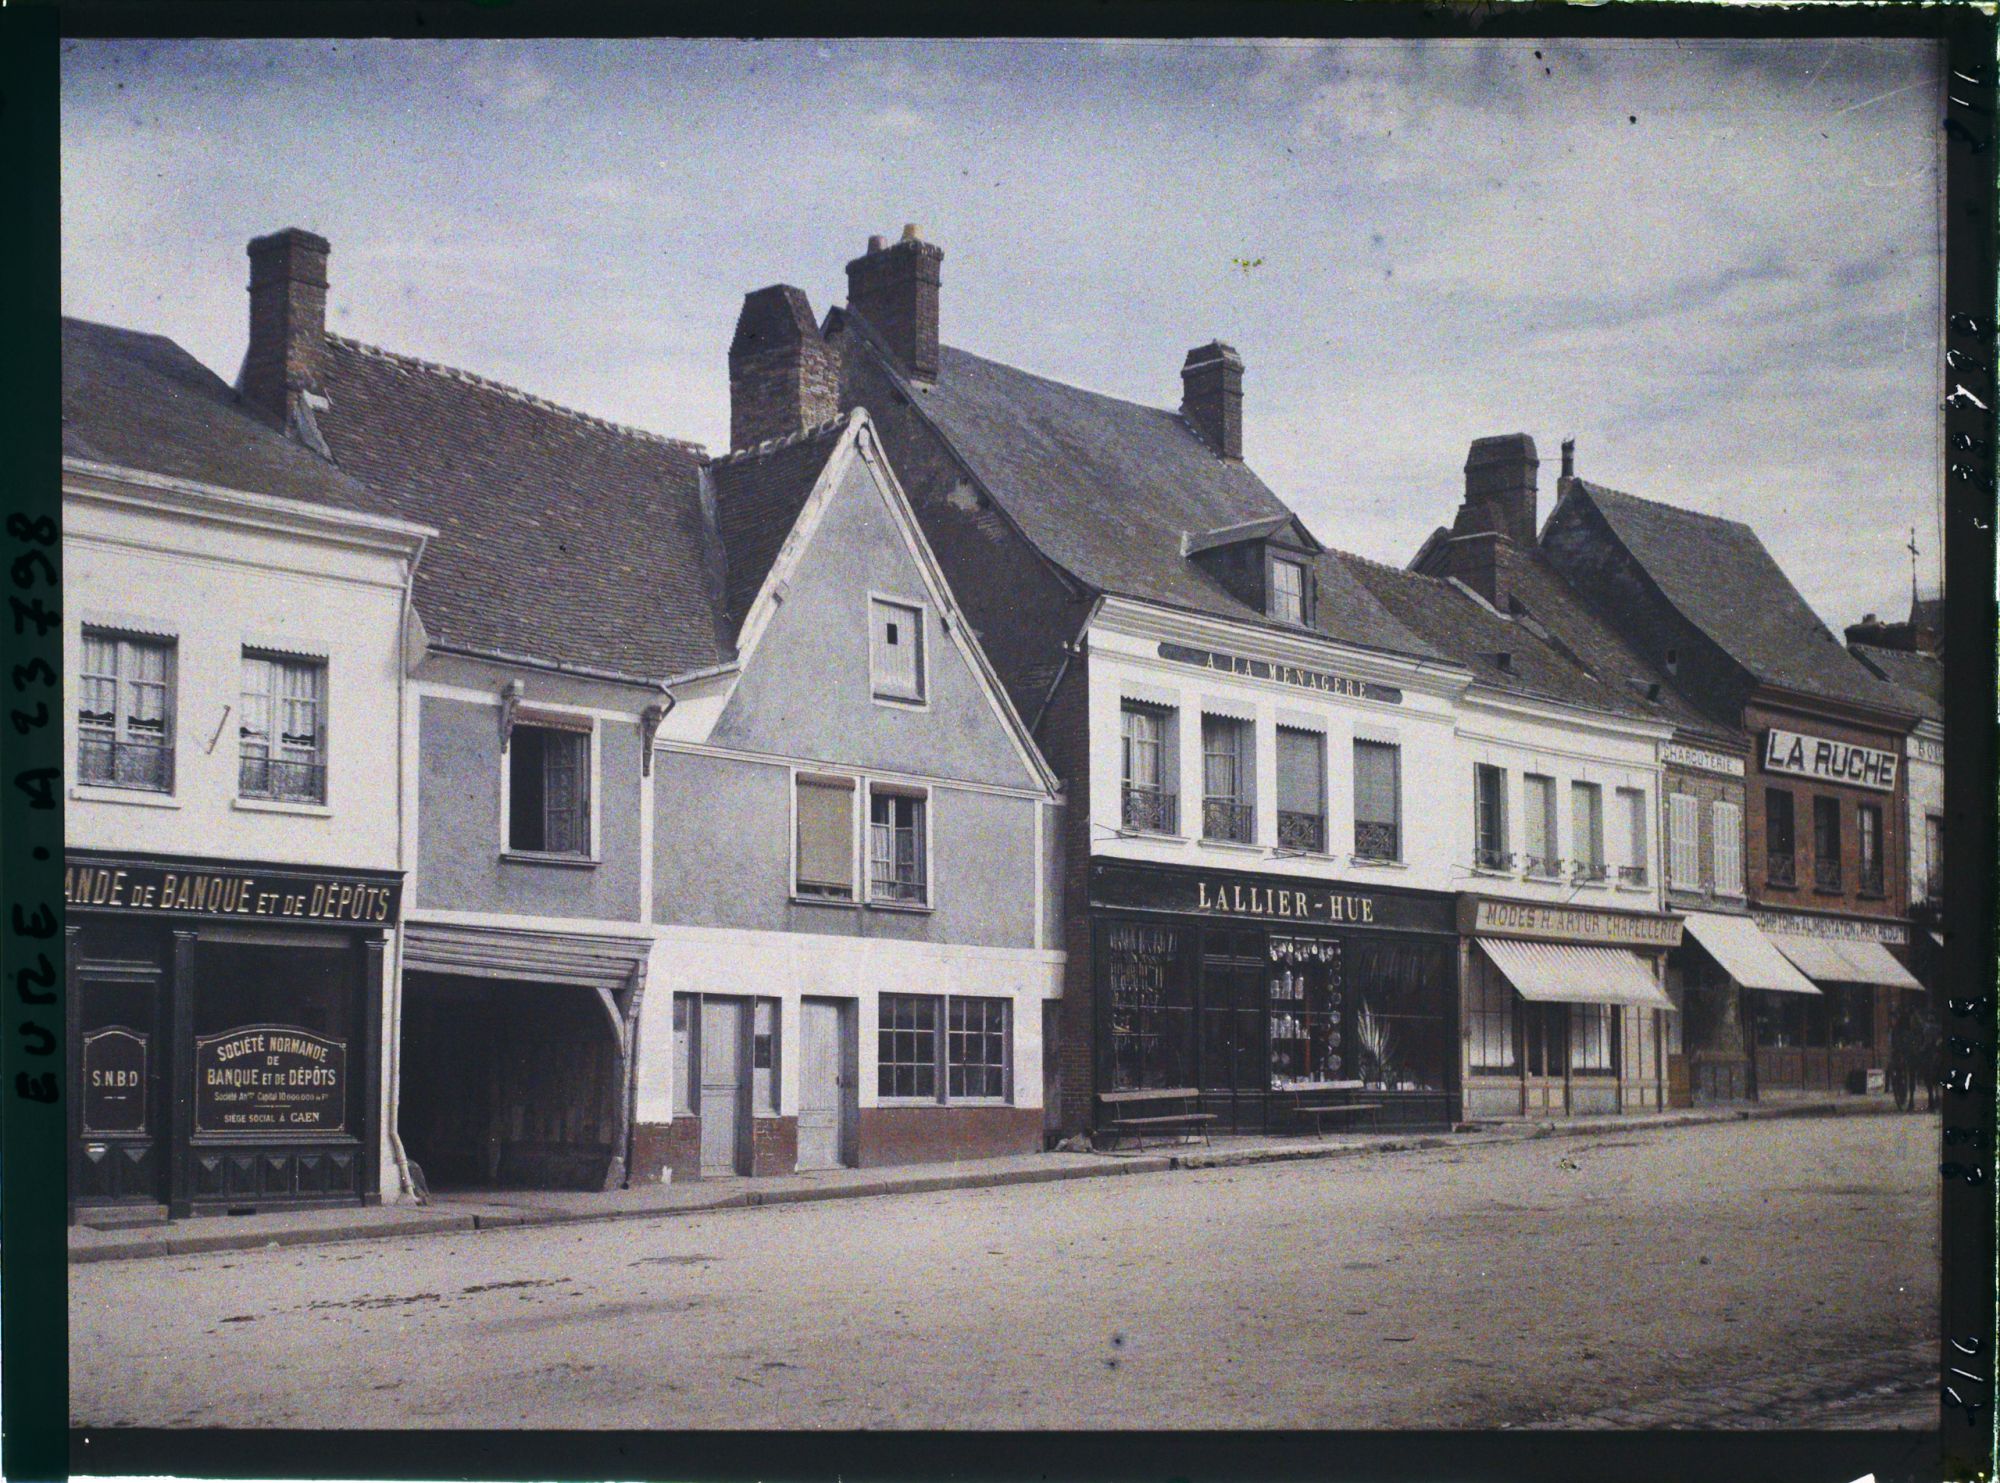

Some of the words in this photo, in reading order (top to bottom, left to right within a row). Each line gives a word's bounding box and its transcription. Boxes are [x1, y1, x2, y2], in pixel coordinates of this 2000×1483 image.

[8, 511, 61, 737] 23798
[1231, 656, 1253, 677] LA
[1767, 732, 1805, 771] LA
[1814, 741, 1896, 785] RUCHE
[14, 768, 62, 810] A
[130, 886, 156, 907] DE
[160, 874, 254, 914] BANQUE
[256, 893, 280, 914] ET
[283, 895, 306, 916] DE
[309, 882, 390, 921] DÉPÔTS
[1487, 903, 1536, 928] MODES
[1606, 916, 1678, 940] CHAPELLERIE
[12, 902, 60, 1104] EURE
[217, 1034, 264, 1061] SOCIÉTÉ
[269, 1037, 328, 1062] NORMANDE
[267, 1056, 279, 1065] DE
[207, 1069, 259, 1087] BANQUE
[262, 1073, 272, 1085] ET
[275, 1074, 286, 1085] DE
[289, 1066, 336, 1086] DÉPÔTS
[249, 1114, 275, 1122] SOCIAL
[290, 1112, 320, 1122] CAEN
